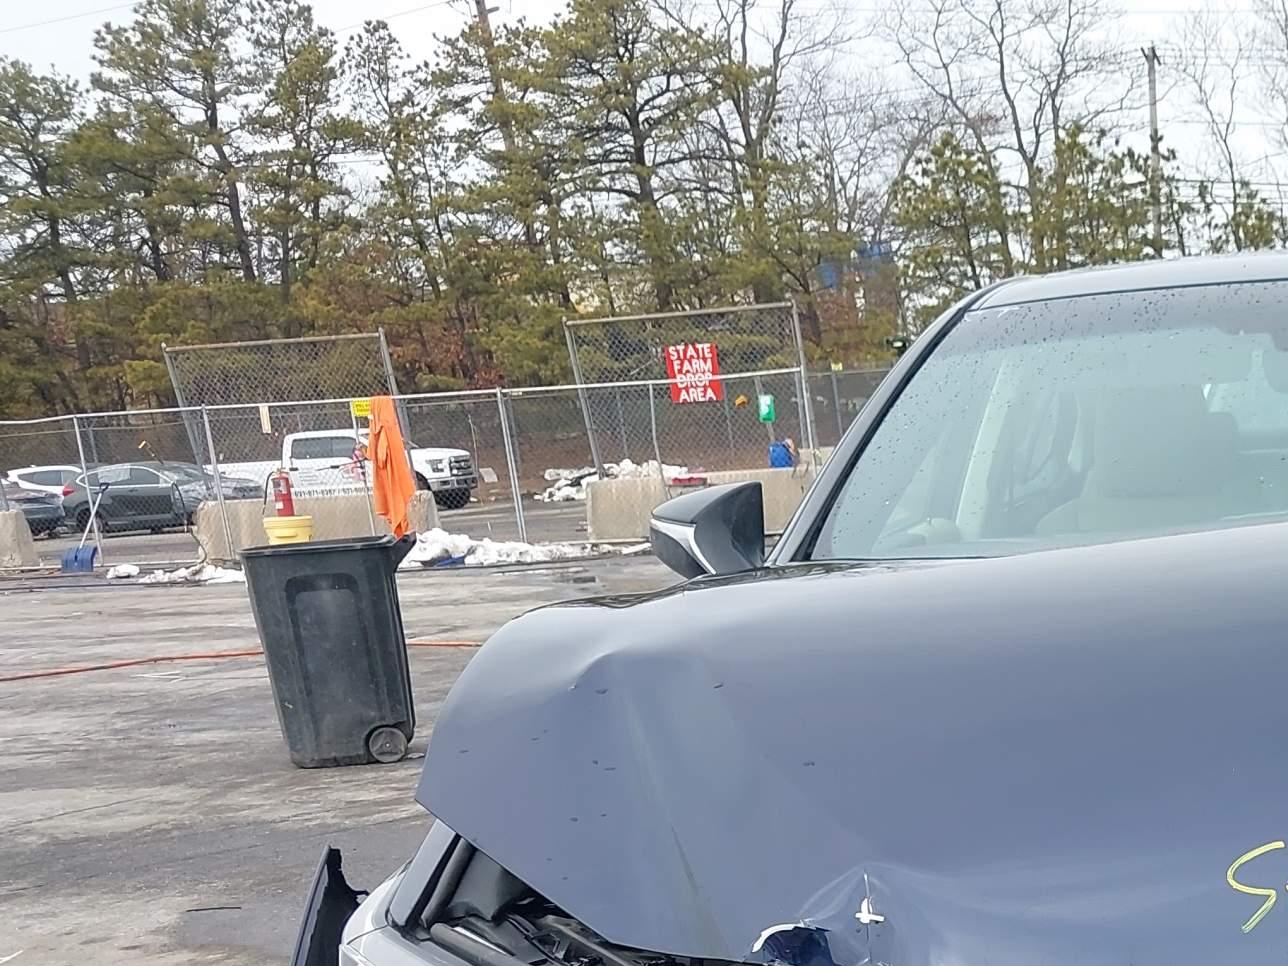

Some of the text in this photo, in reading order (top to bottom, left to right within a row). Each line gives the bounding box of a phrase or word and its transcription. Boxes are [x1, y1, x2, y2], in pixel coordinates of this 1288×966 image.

[669, 343, 712, 360] STATE
[673, 359, 713, 375] FARM
[677, 372, 713, 388] DROP
[680, 387, 717, 403] AREA
